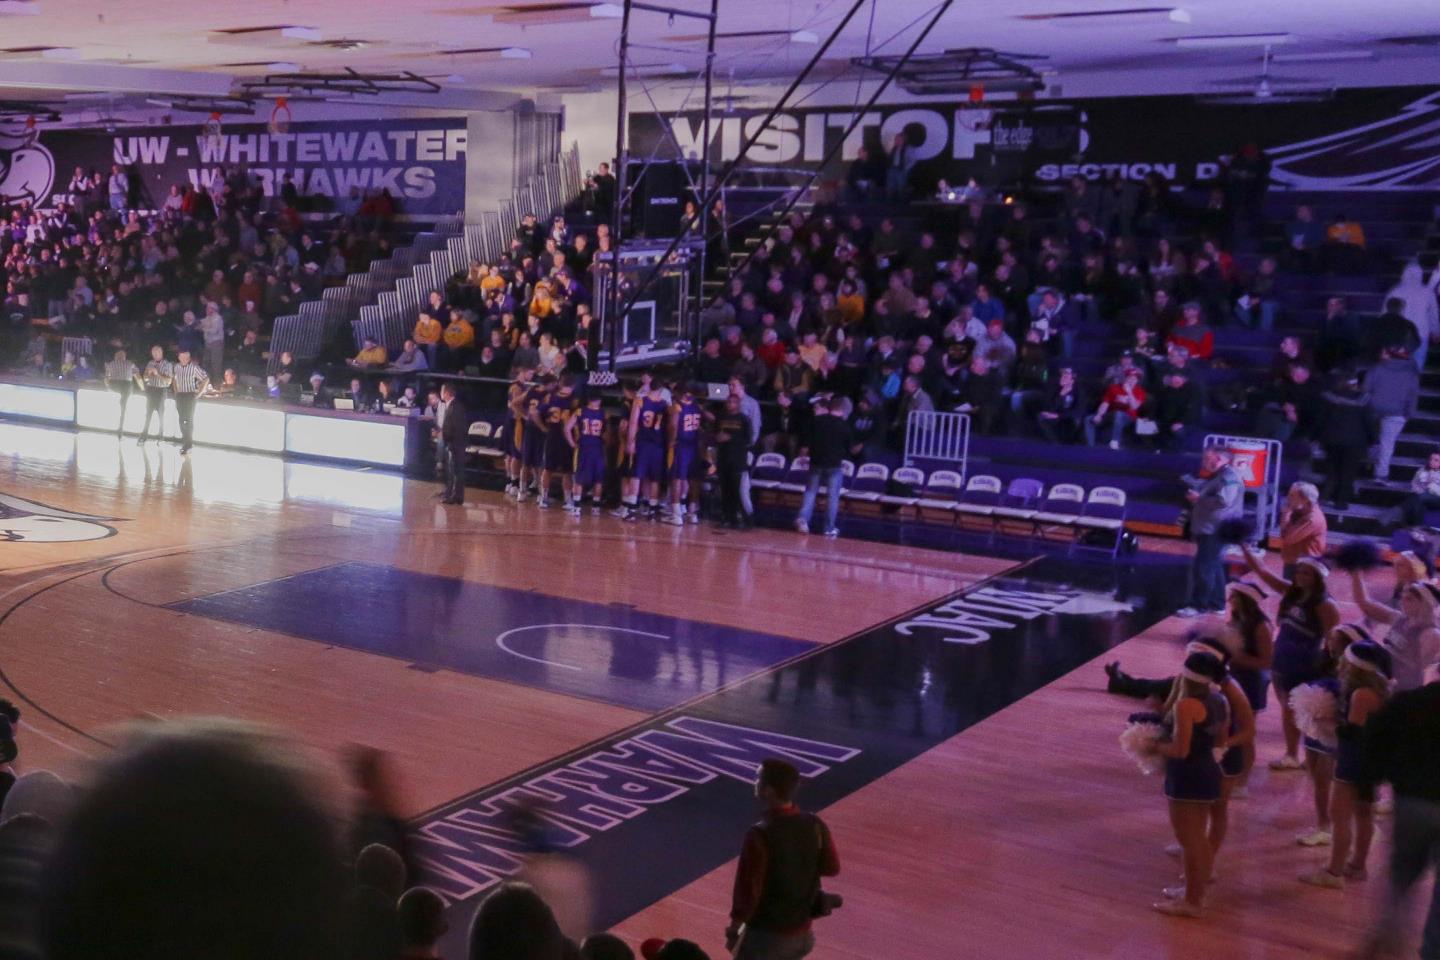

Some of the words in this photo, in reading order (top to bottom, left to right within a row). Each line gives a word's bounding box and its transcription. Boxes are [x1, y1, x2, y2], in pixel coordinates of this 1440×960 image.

[113, 136, 170, 165] UW
[1038, 162, 1177, 181] SECTION
[188, 166, 436, 198] WRHAWKS
[582, 418, 603, 437] 12
[683, 413, 702, 432] 25
